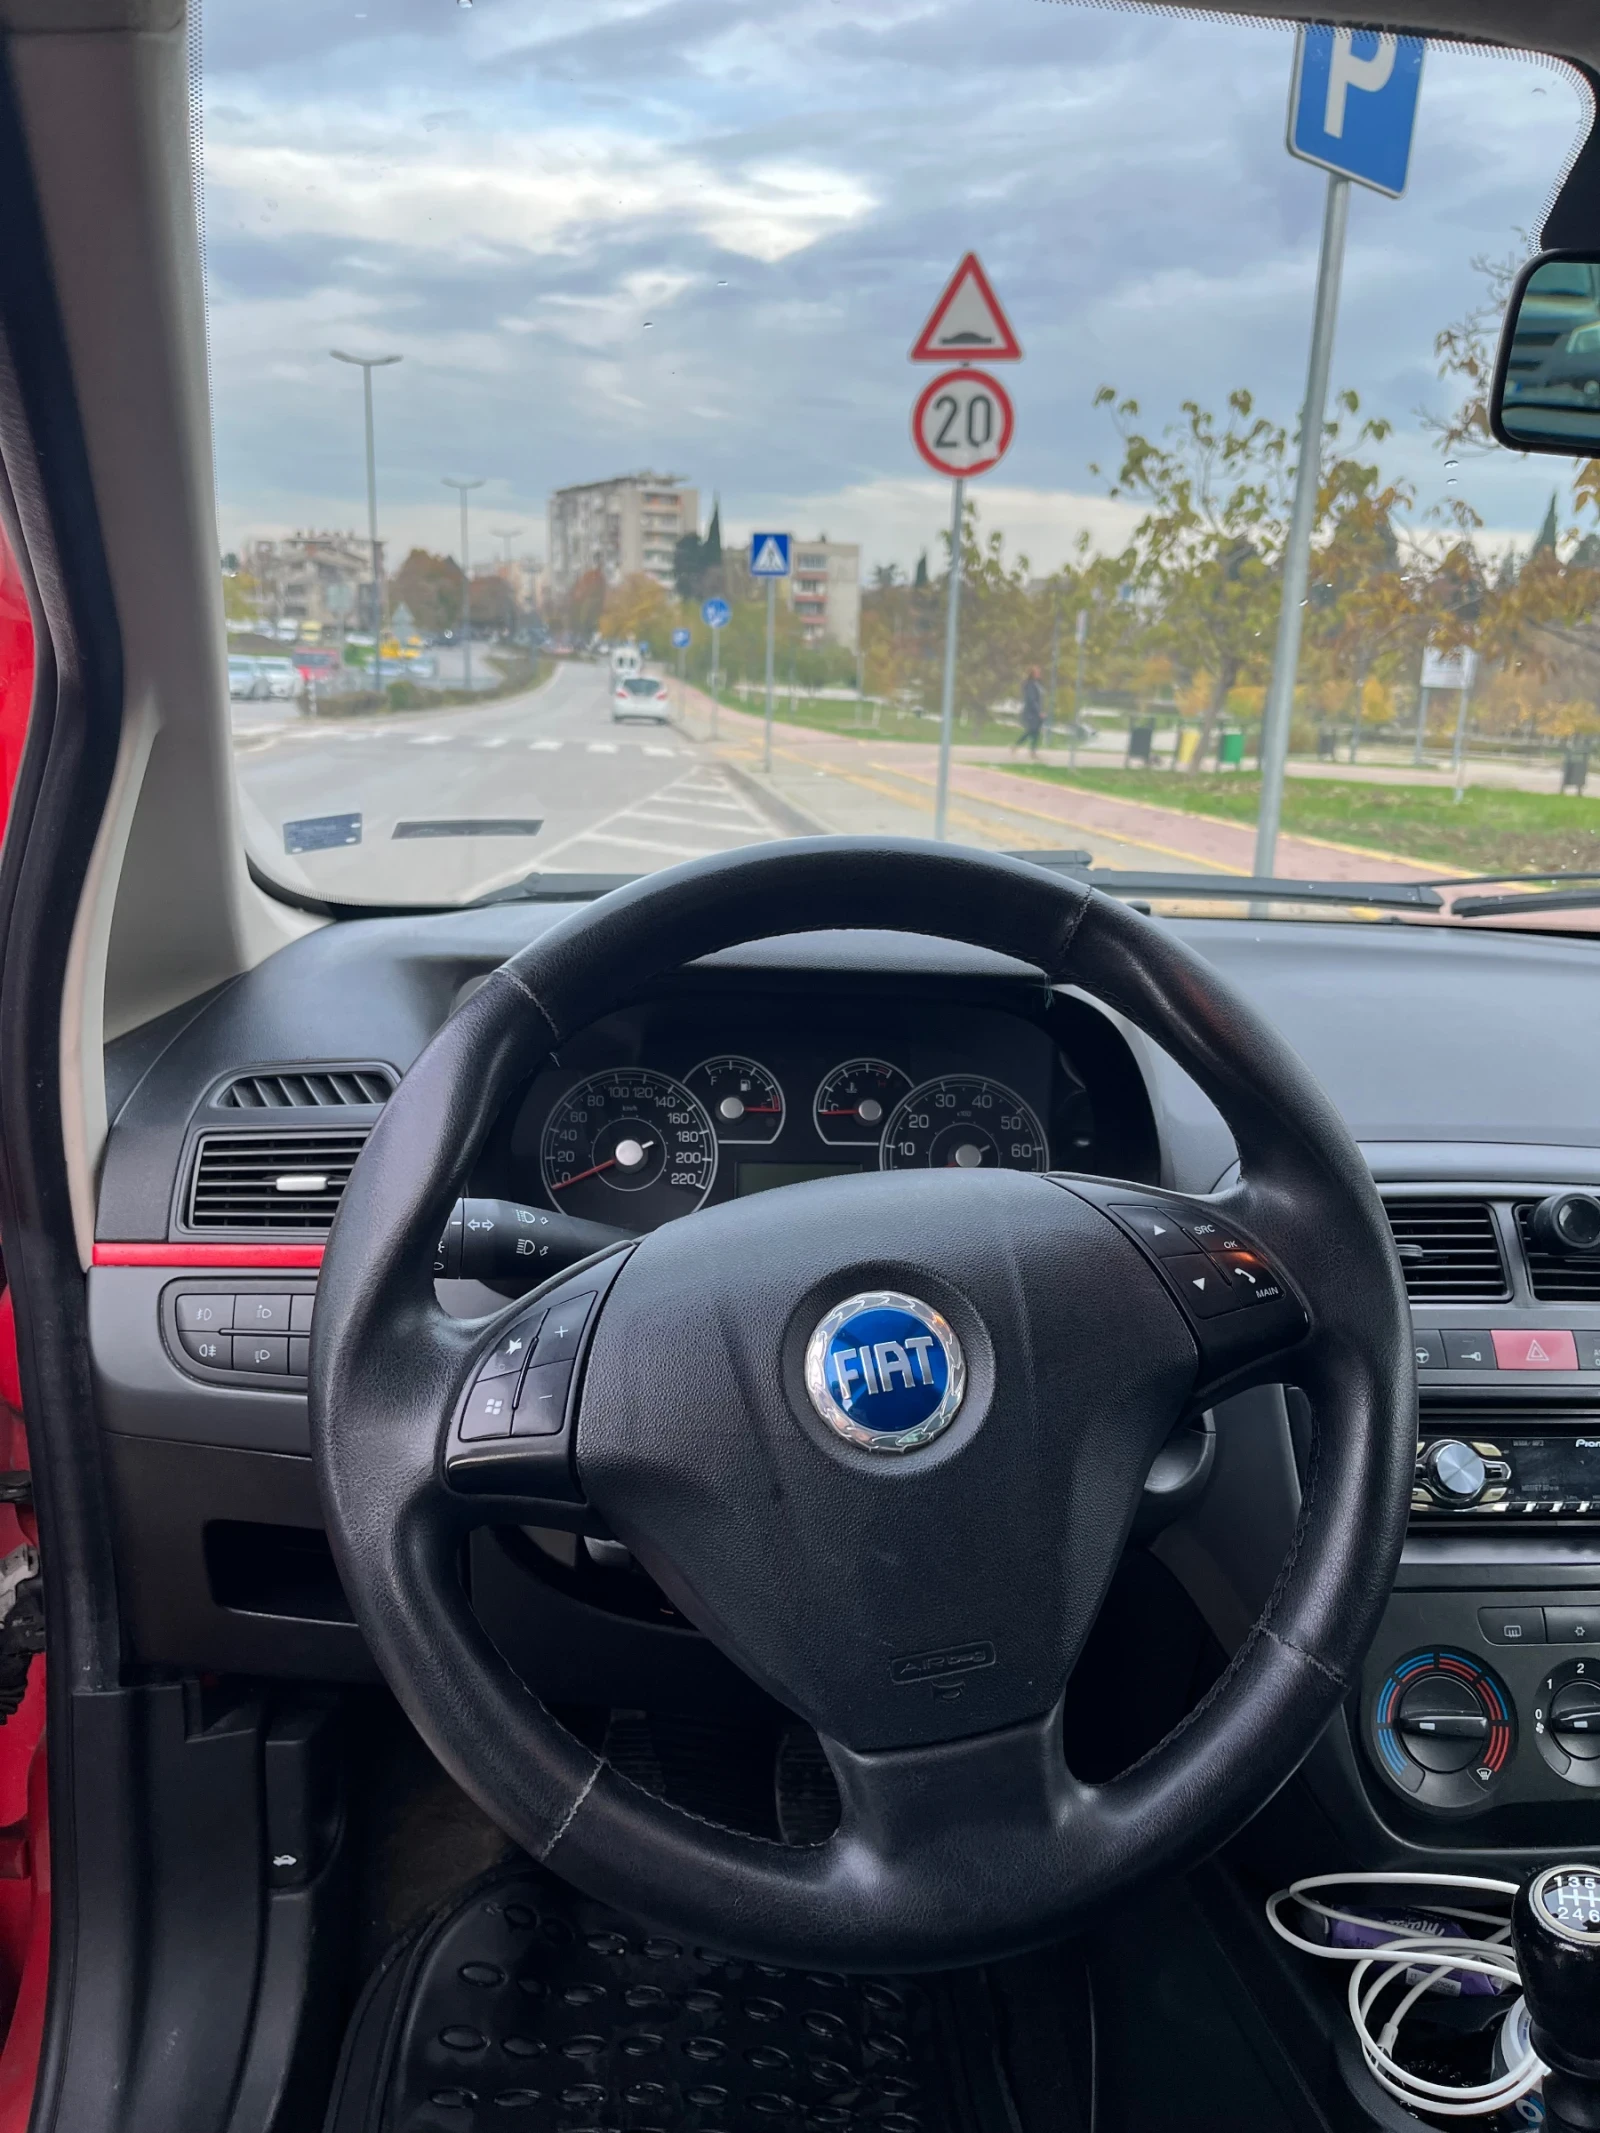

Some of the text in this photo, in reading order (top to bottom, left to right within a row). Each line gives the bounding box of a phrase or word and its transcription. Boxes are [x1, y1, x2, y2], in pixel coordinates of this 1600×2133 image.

[933, 394, 991, 448] 20
[710, 1075, 717, 1086] F
[608, 1086, 630, 1098] 100
[633, 1087, 653, 1099] 120
[587, 1095, 604, 1107] 80
[655, 1096, 676, 1108] 140
[935, 1094, 956, 1108] 30
[972, 1095, 992, 1108] 40
[570, 1111, 587, 1123] 60
[668, 1112, 689, 1124] 160
[909, 1114, 929, 1129] 20
[1001, 1116, 1021, 1130] 50
[559, 1129, 577, 1141] 40
[676, 1131, 698, 1142] 180
[898, 1142, 915, 1156] 10
[1011, 1144, 1032, 1158] 60
[557, 1151, 575, 1162] 20
[675, 1152, 701, 1163] 200
[671, 1173, 696, 1184] 220
[1193, 1224, 1216, 1236] SRC
[1223, 1240, 1238, 1249] OK
[1255, 1287, 1279, 1298] MAIN
[833, 1336, 935, 1400] FIAT
[1576, 1663, 1585, 1674] 2
[1546, 1678, 1553, 1690] 1
[1535, 1708, 1542, 1720] 0
[1553, 1875, 1596, 1889] 1 3 5
[1557, 1906, 1600, 1923] 2 4 6
